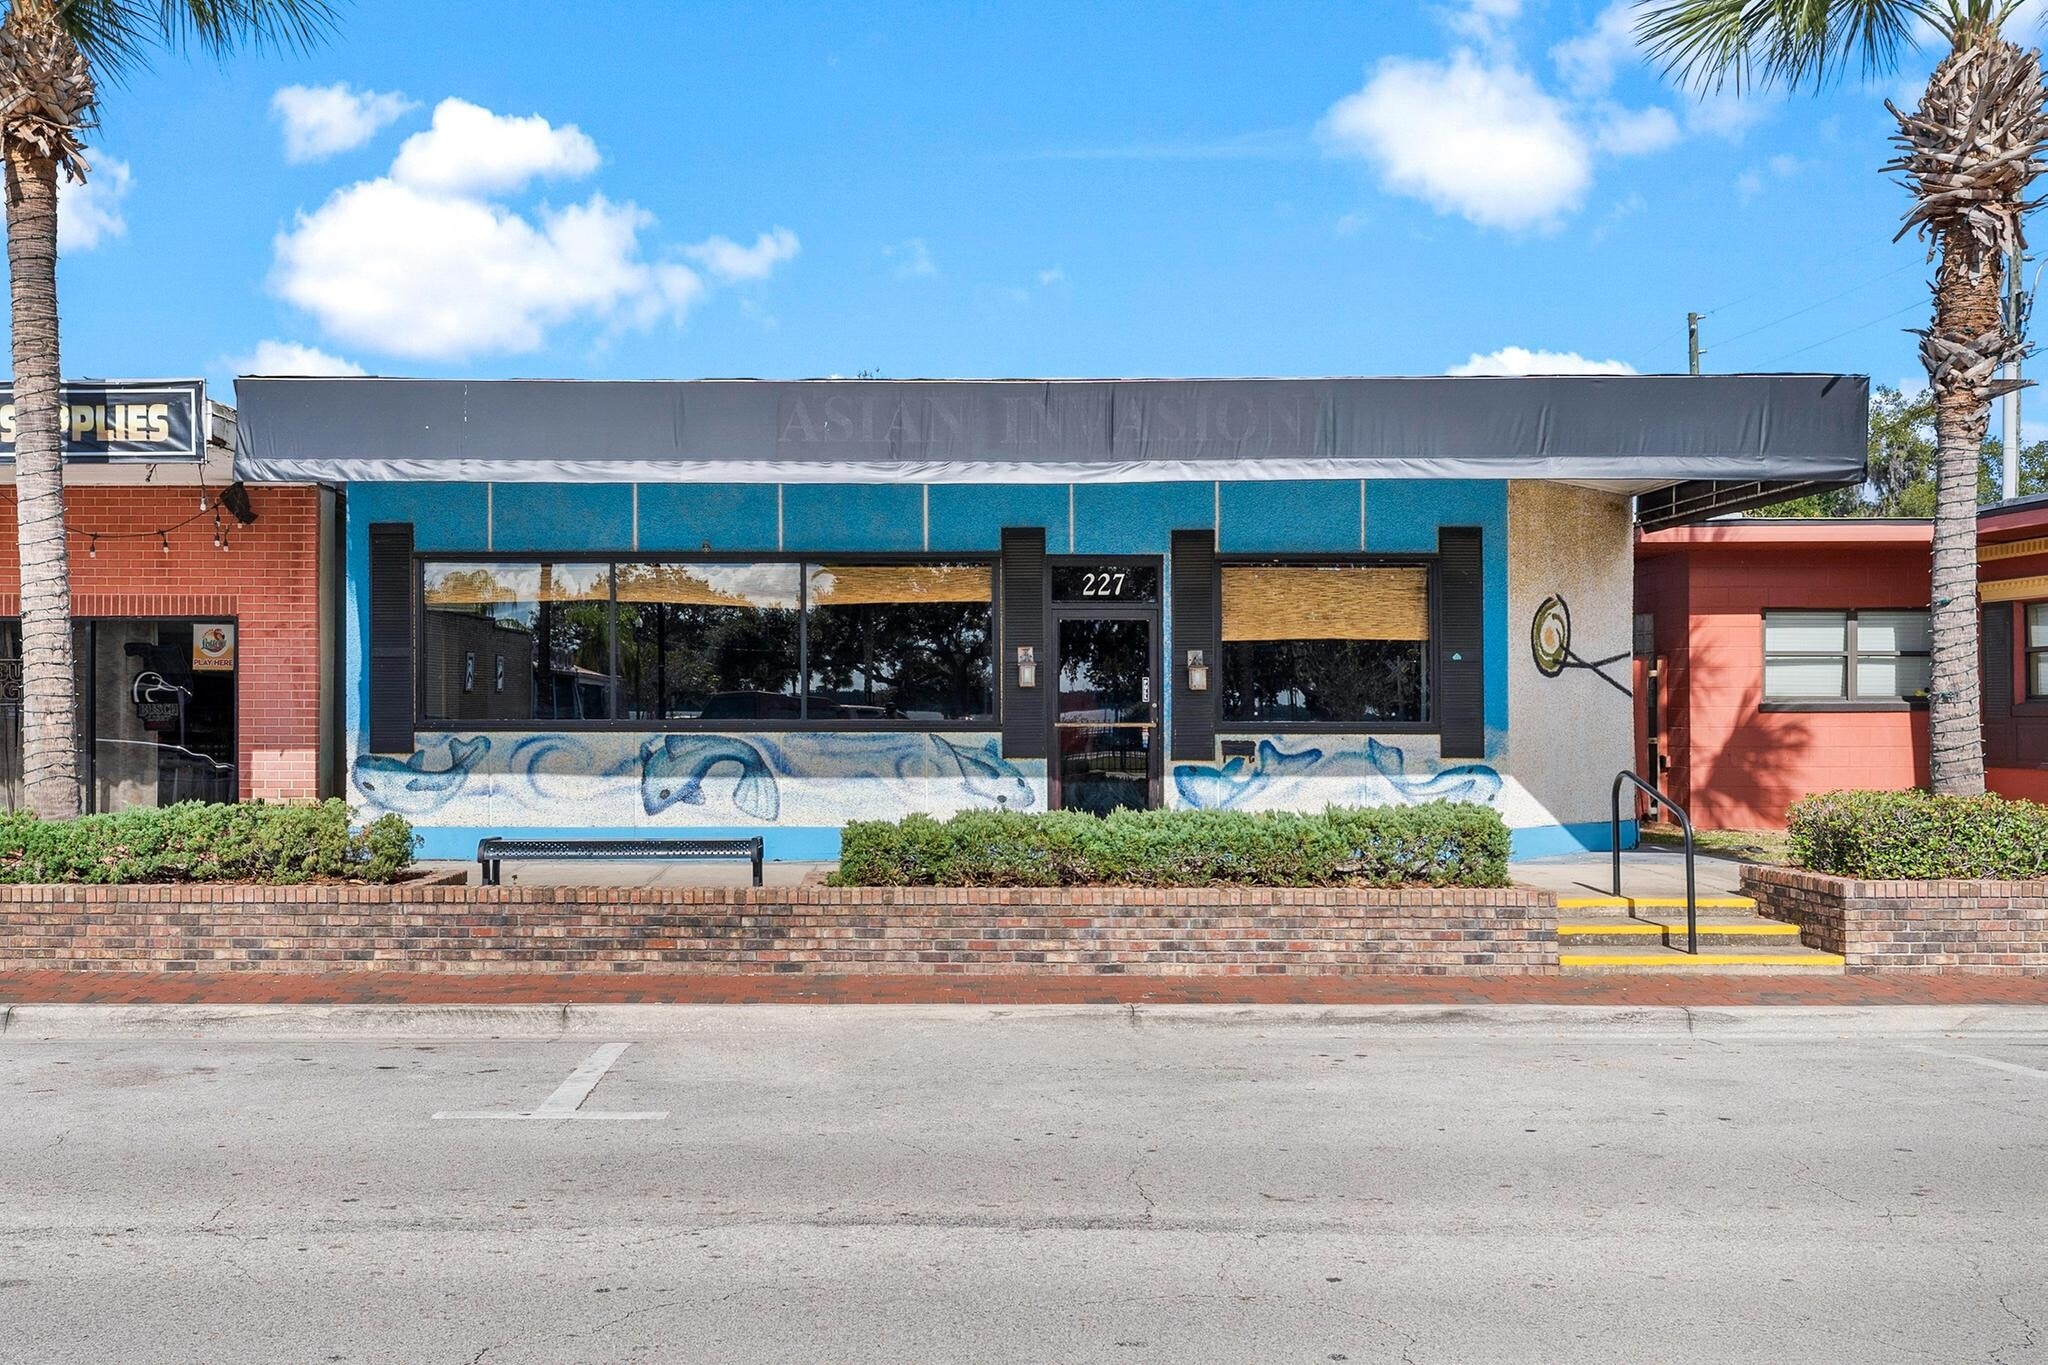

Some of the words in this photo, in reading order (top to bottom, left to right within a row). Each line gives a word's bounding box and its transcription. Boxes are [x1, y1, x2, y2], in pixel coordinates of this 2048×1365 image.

[0, 404, 169, 443] SPLIES
[778, 395, 967, 443] ASIAN
[1000, 395, 1306, 443] INVASION
[1082, 572, 1126, 596] 227
